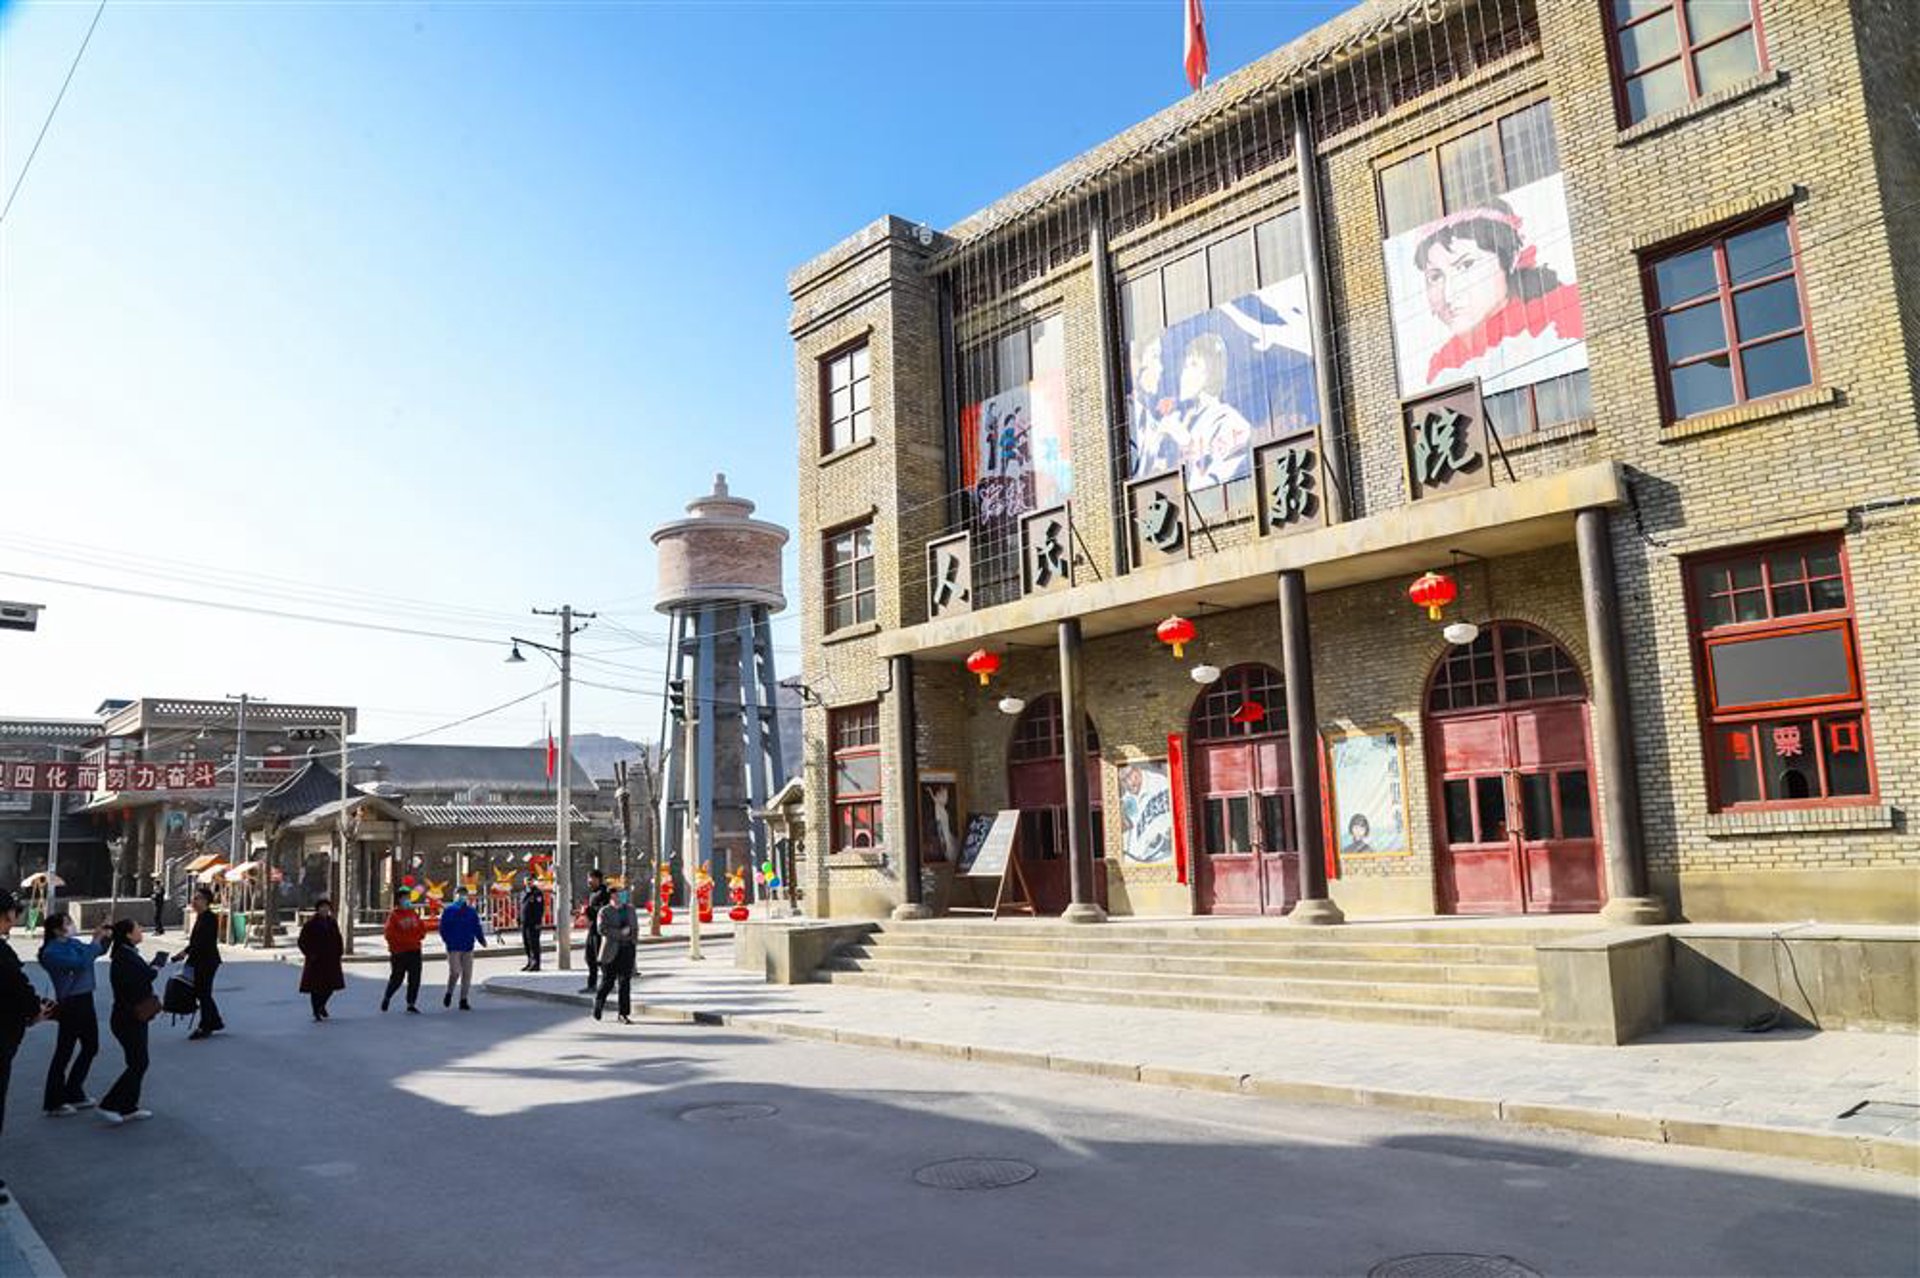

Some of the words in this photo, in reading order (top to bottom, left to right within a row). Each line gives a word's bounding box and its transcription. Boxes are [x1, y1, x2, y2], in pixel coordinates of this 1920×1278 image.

[934, 405, 1477, 602] 人民电影院
[0, 764, 214, 789] 四化而努力奋斗
